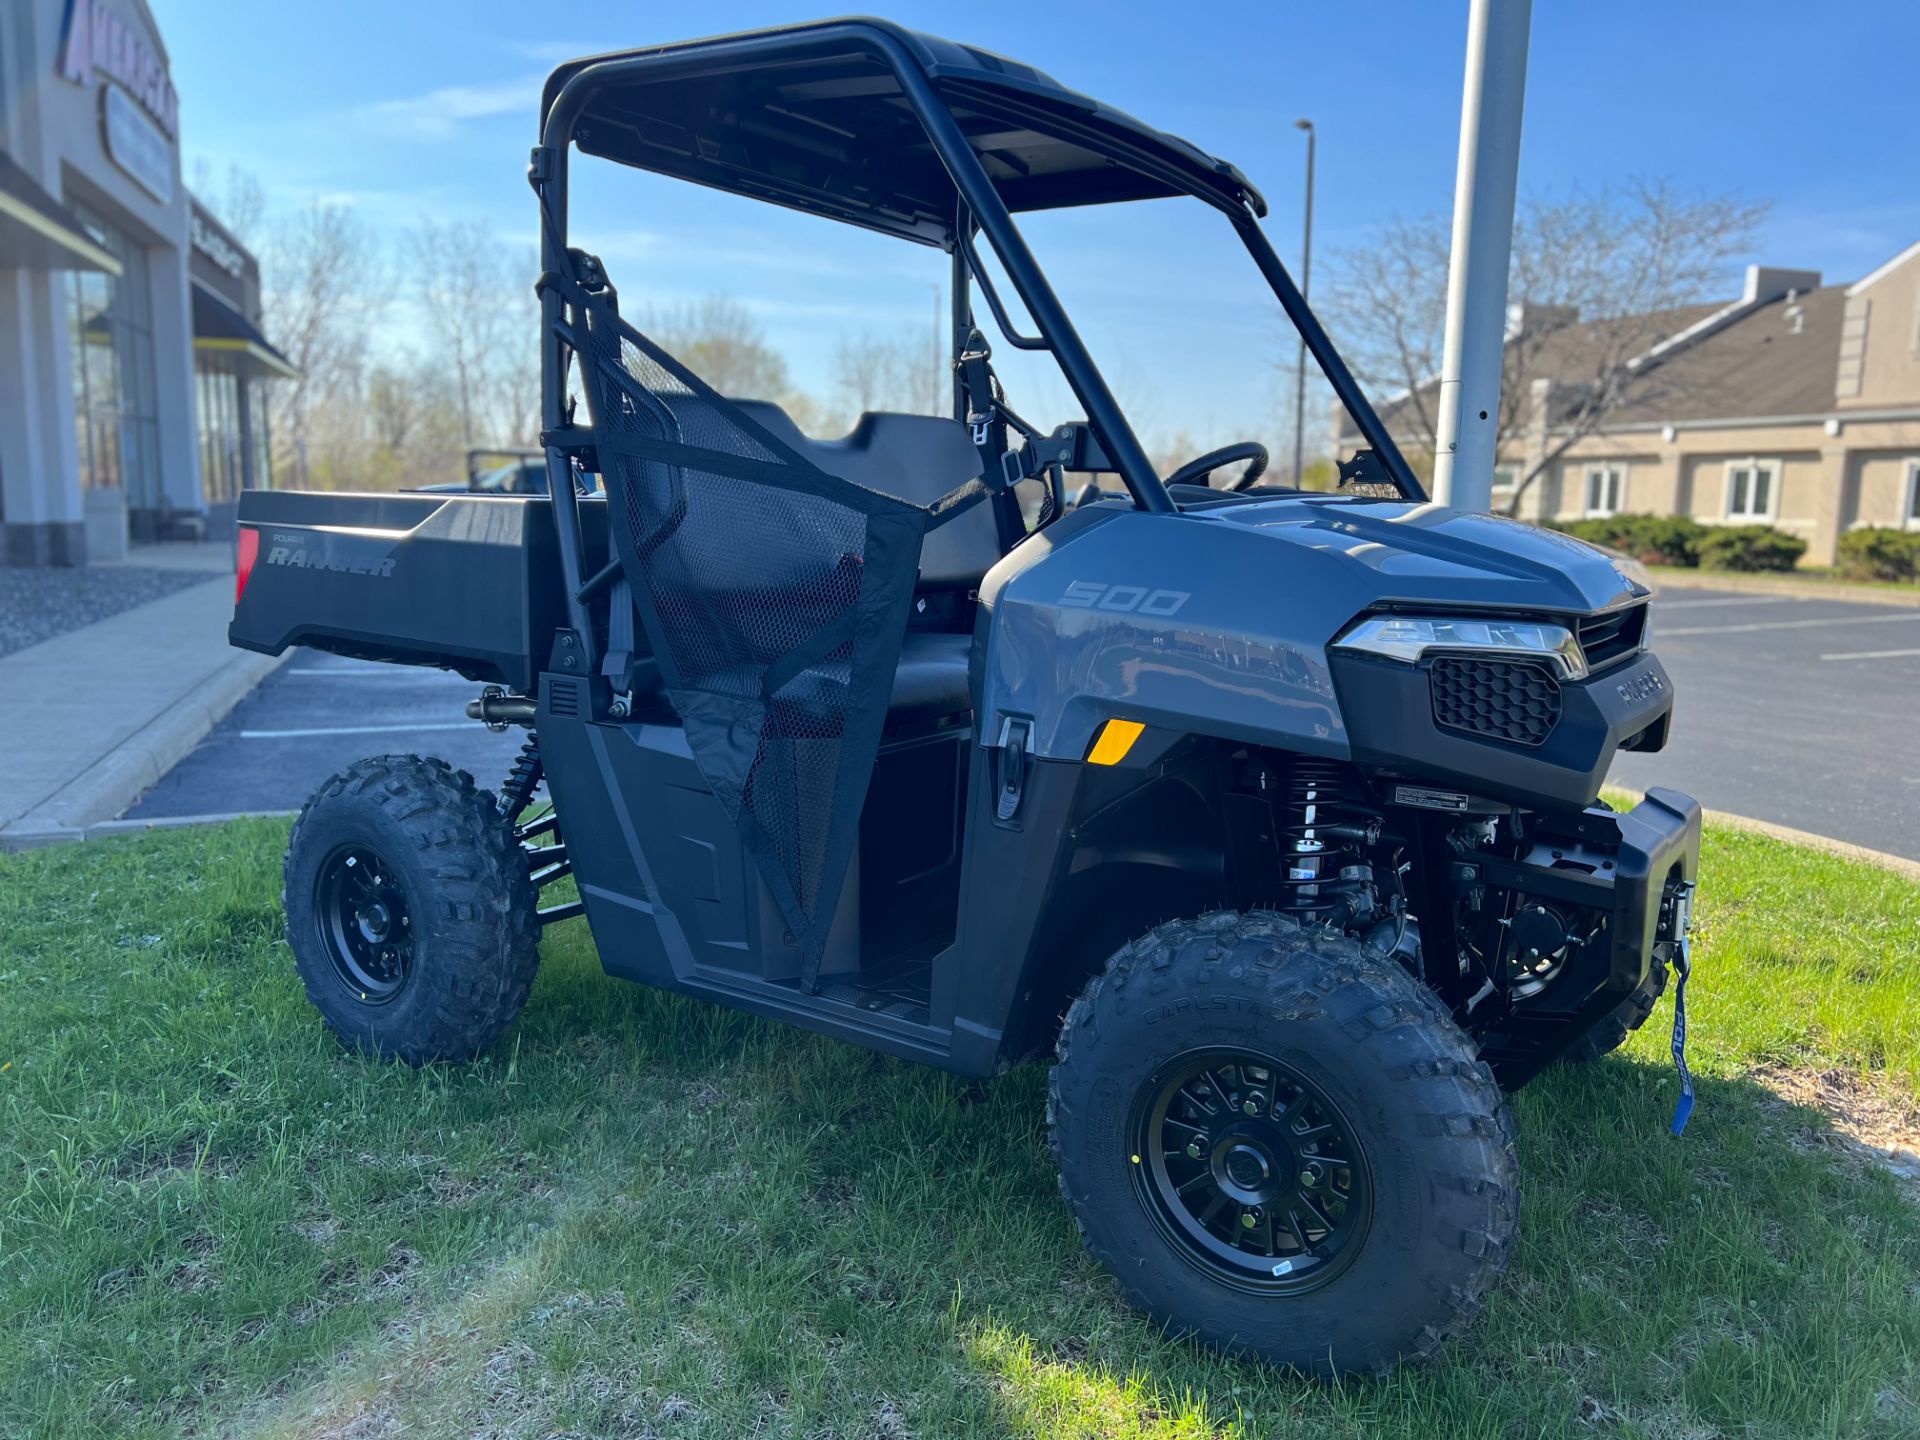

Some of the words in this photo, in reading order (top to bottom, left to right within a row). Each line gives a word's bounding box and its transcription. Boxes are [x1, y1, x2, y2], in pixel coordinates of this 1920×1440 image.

[267, 547, 396, 577] RANGER
[1058, 581, 1191, 616] 500
[1672, 1010, 1693, 1098] POLARIS
